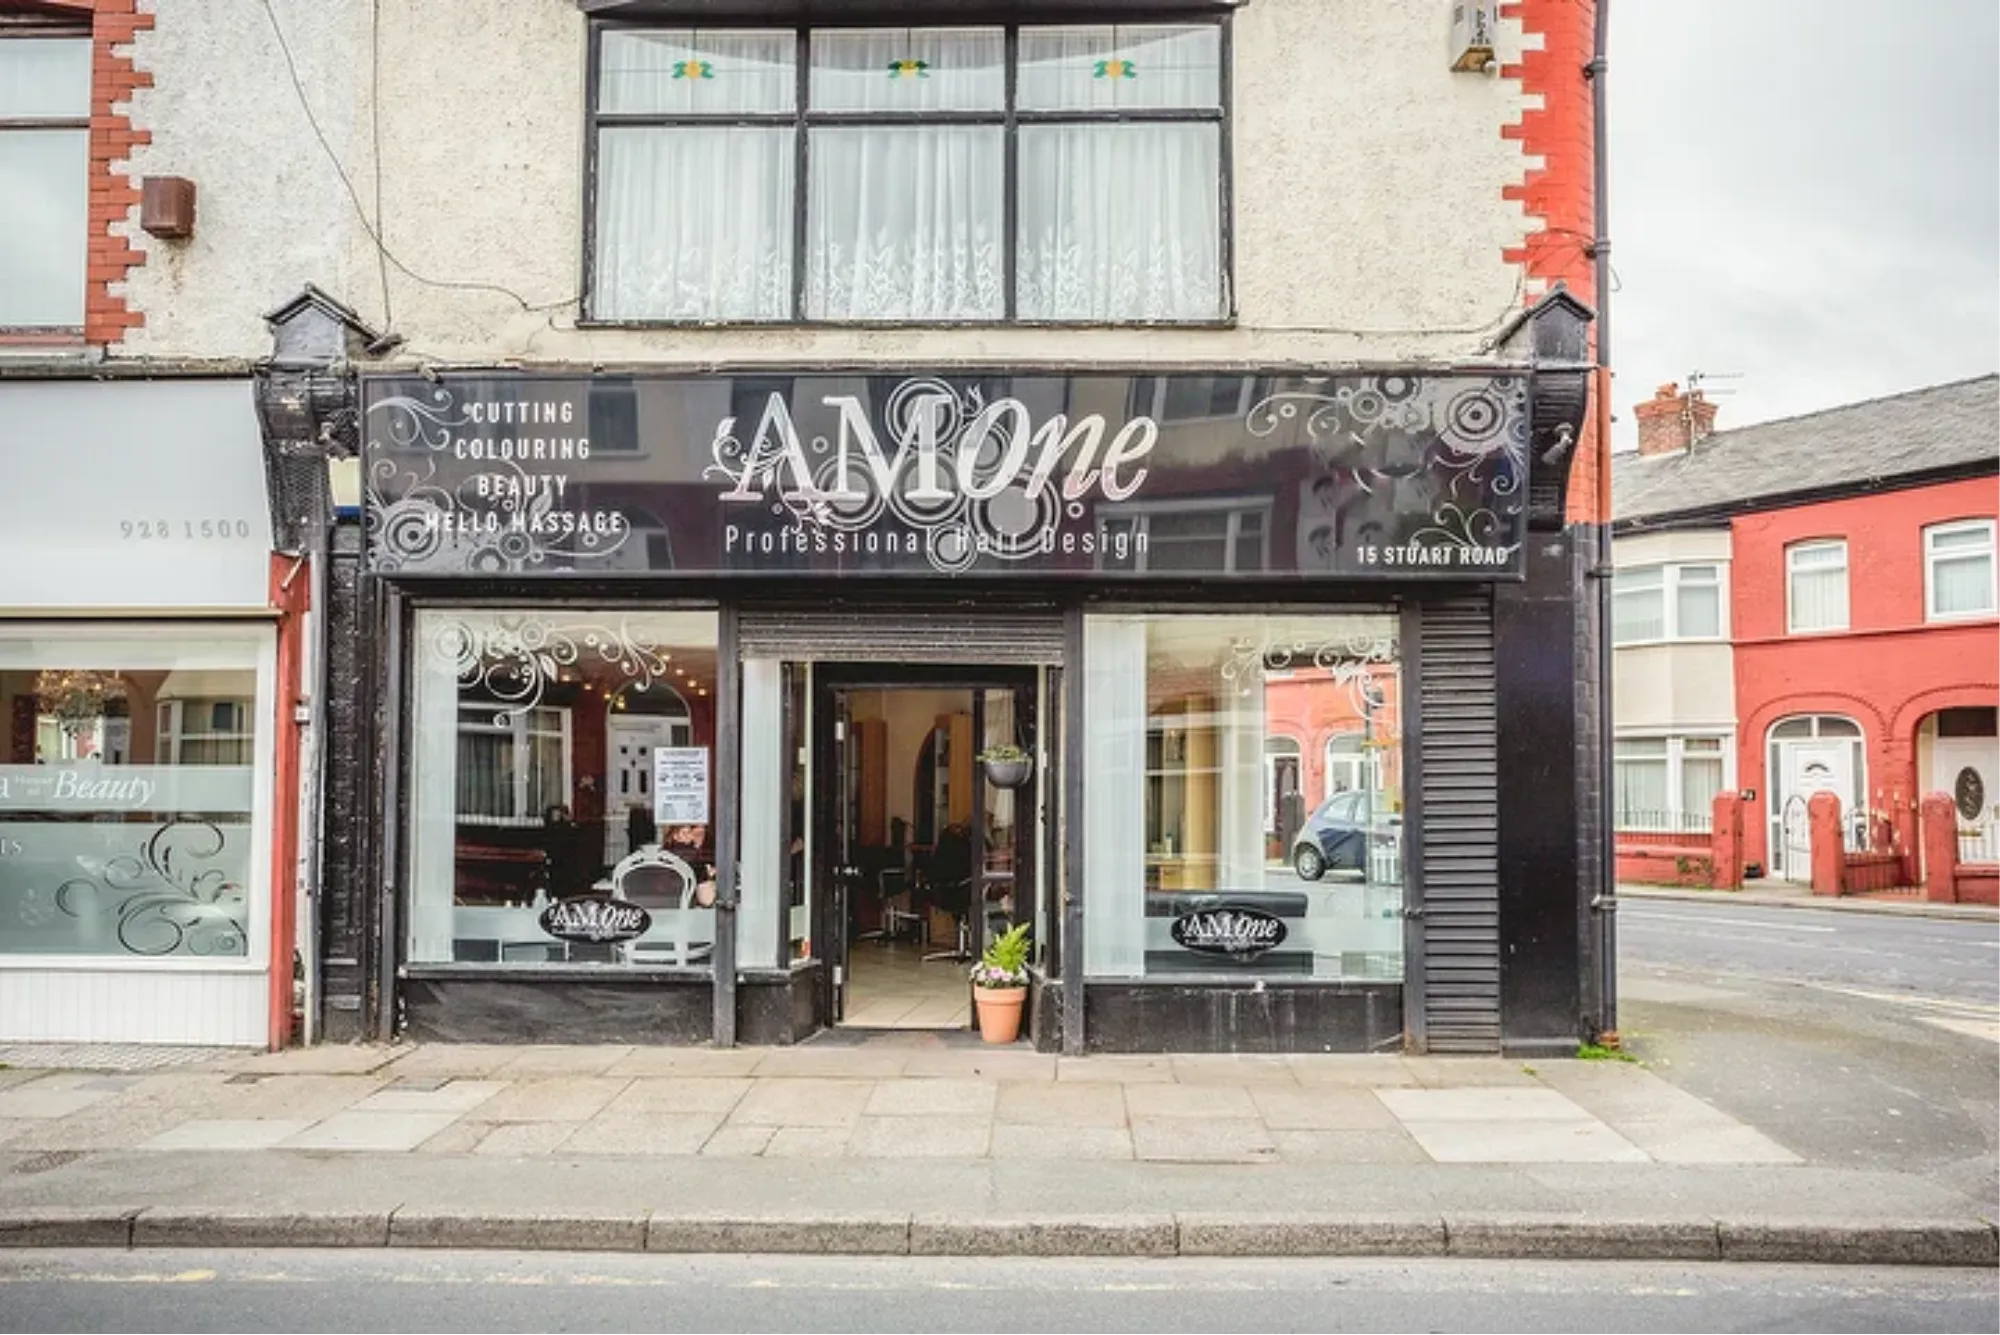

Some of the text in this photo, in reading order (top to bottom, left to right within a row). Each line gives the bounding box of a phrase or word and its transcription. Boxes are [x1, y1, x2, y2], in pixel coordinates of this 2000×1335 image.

[471, 402, 573, 424] CUTTING
[455, 438, 590, 460] COLOURING
[478, 475, 568, 497] BEAUTY
[120, 519, 250, 539] 928 1500
[511, 511, 622, 533] MASSAGE
[725, 524, 1149, 560] Professional Hair Design
[1357, 545, 1509, 565] 15 STUART ROAD
[53, 769, 156, 809] Beauty
